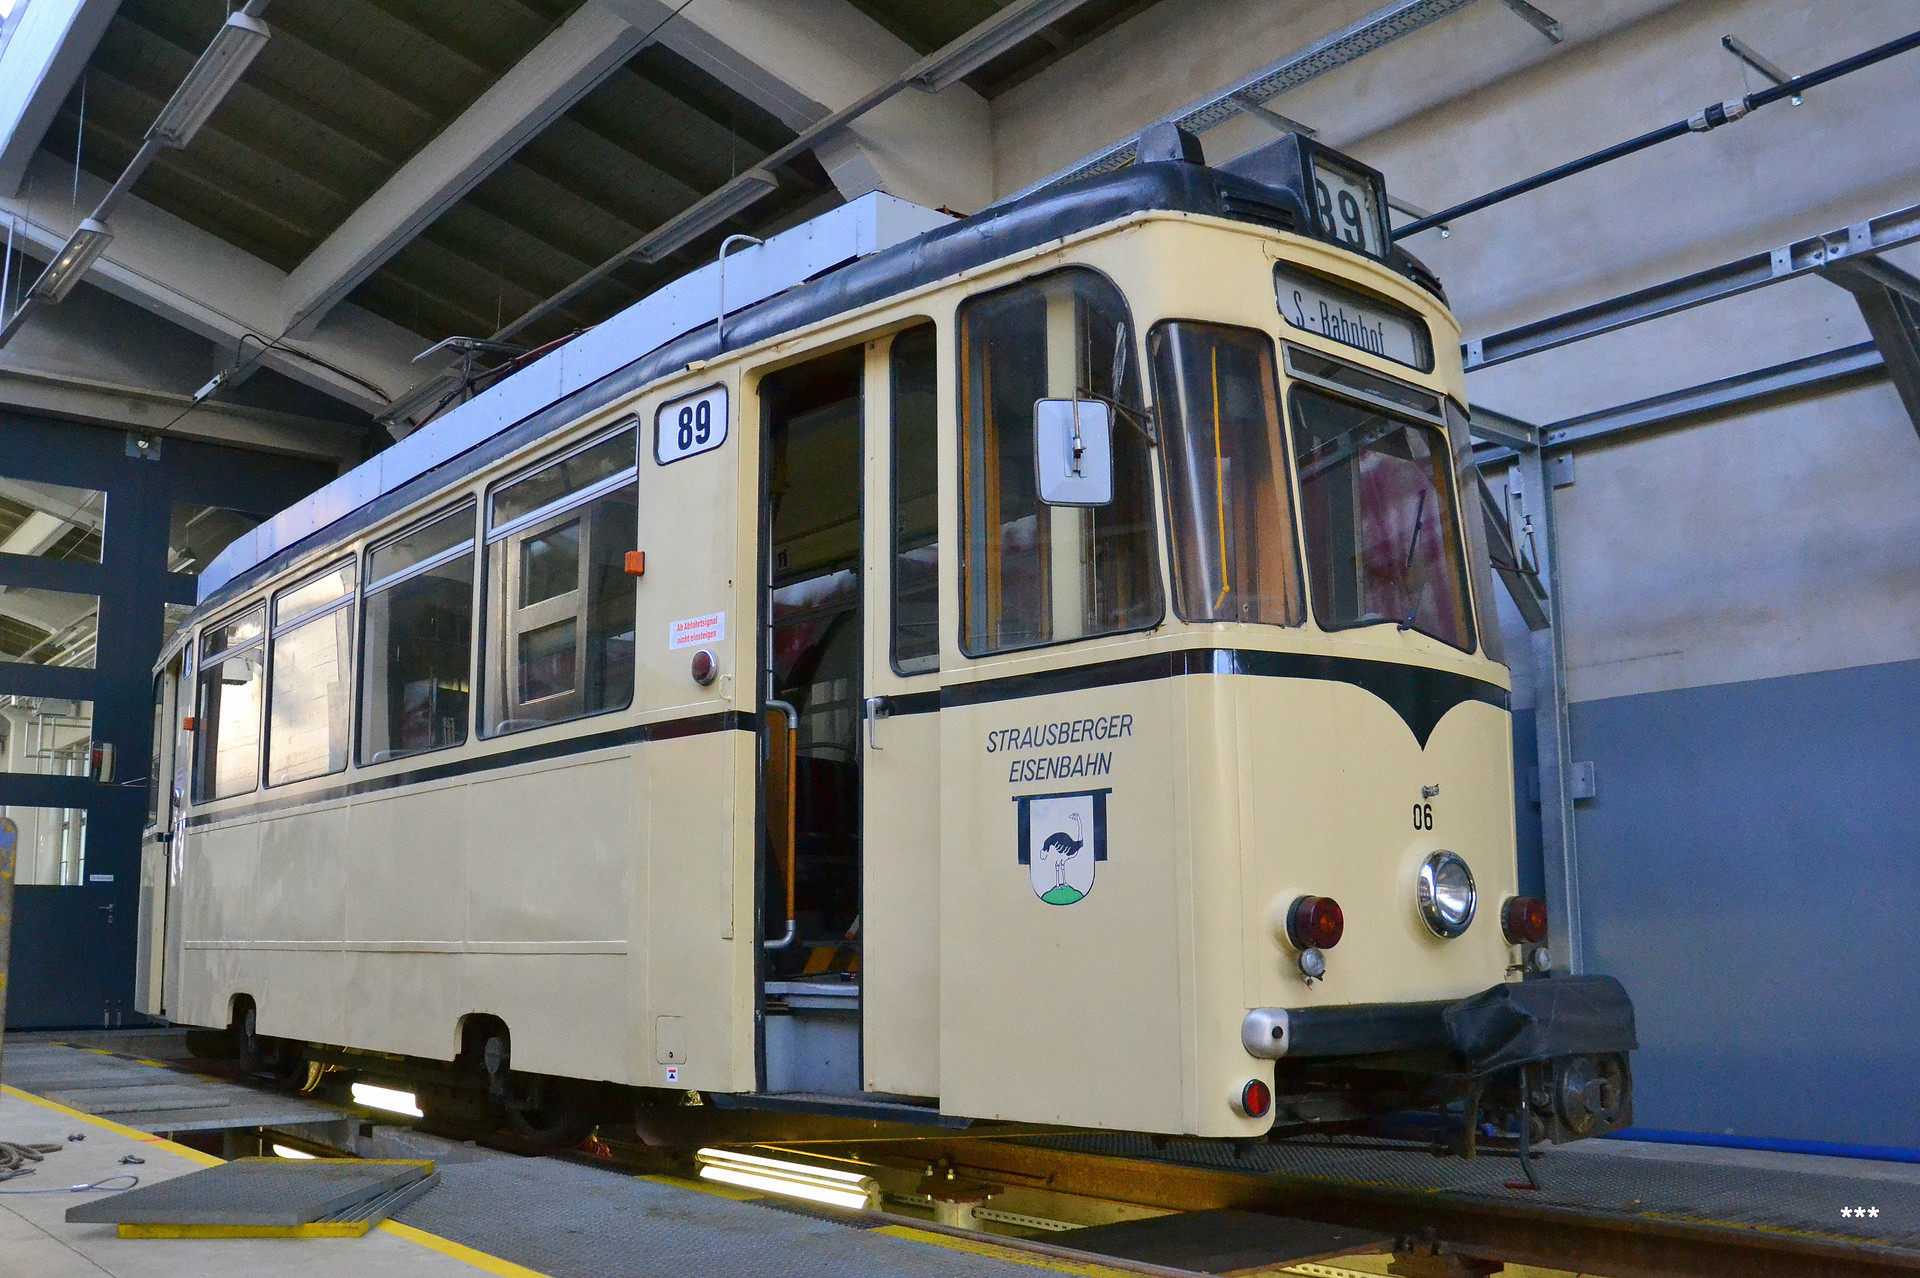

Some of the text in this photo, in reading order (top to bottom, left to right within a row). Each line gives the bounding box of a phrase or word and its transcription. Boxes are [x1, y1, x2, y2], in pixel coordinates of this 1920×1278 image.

[677, 400, 711, 451] 89
[676, 623, 684, 632] Ab
[676, 630, 717, 644] nicht einsteigen
[986, 714, 1133, 753] STRAUSBERGER
[1009, 751, 1112, 783] EISENBAHN
[1413, 803, 1433, 831] 06
